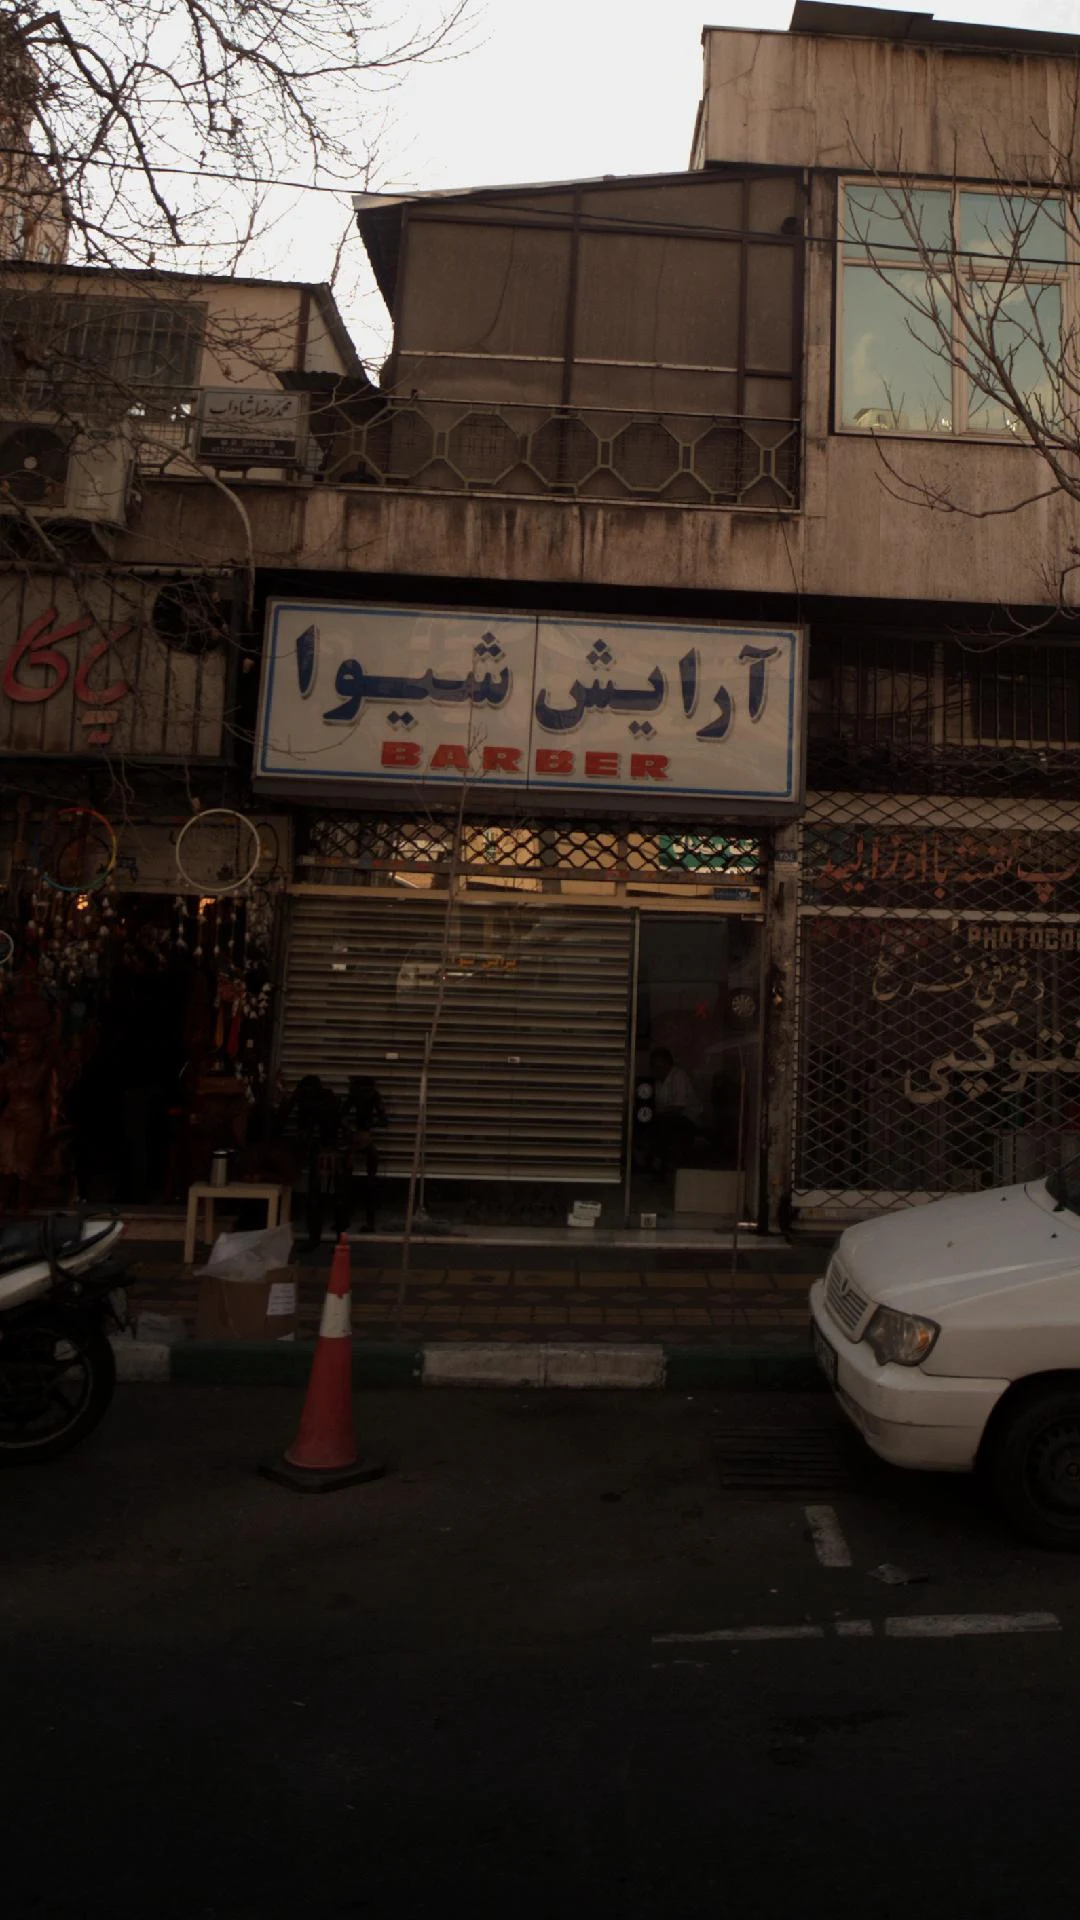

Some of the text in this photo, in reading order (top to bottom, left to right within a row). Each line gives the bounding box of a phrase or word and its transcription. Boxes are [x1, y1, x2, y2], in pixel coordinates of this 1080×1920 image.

[296, 624, 783, 743] آرایش شیوا
[380, 741, 672, 782] BARBER
[967, 927, 1080, 951] PHOTOCO
[902, 1011, 1080, 1105] توکپی
